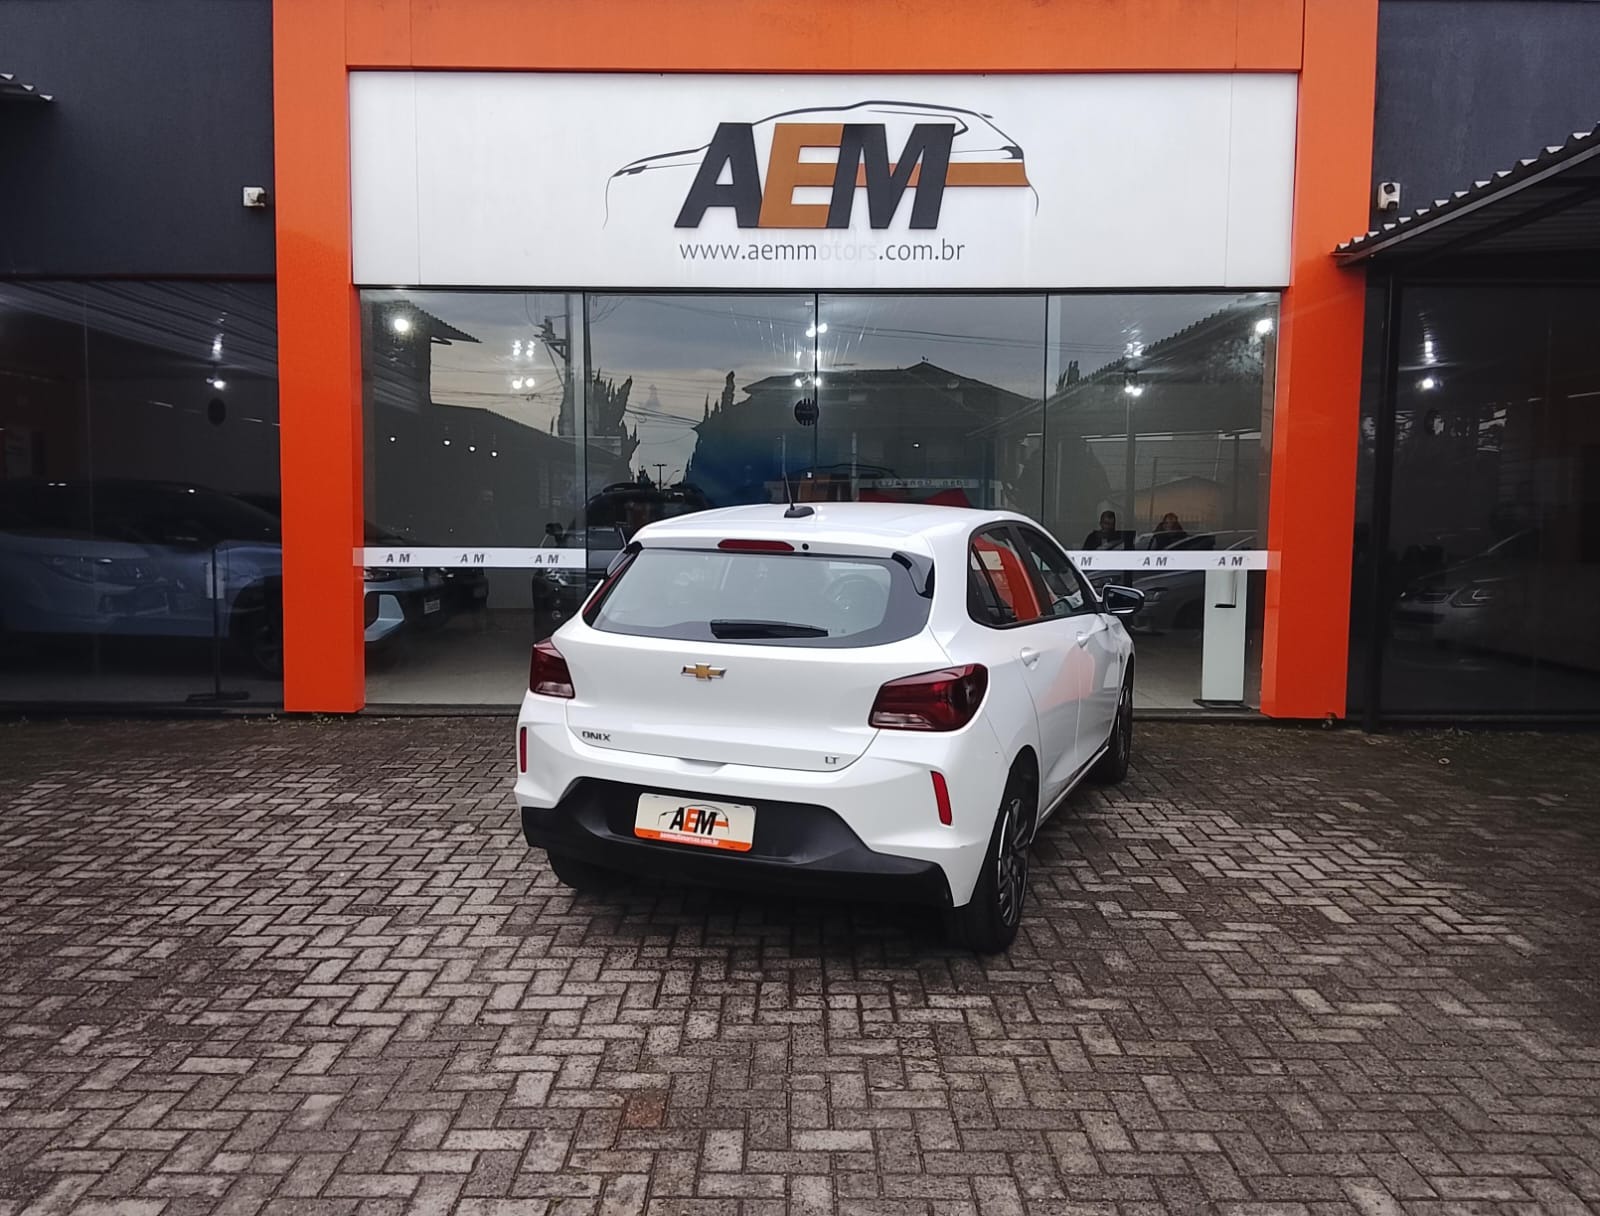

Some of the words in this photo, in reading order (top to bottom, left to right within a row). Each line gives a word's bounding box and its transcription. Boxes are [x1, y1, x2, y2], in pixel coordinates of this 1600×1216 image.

[674, 122, 956, 230] AEM
[582, 731, 611, 741] ONIX
[825, 756, 840, 764] LT
[669, 807, 718, 835] AEM
